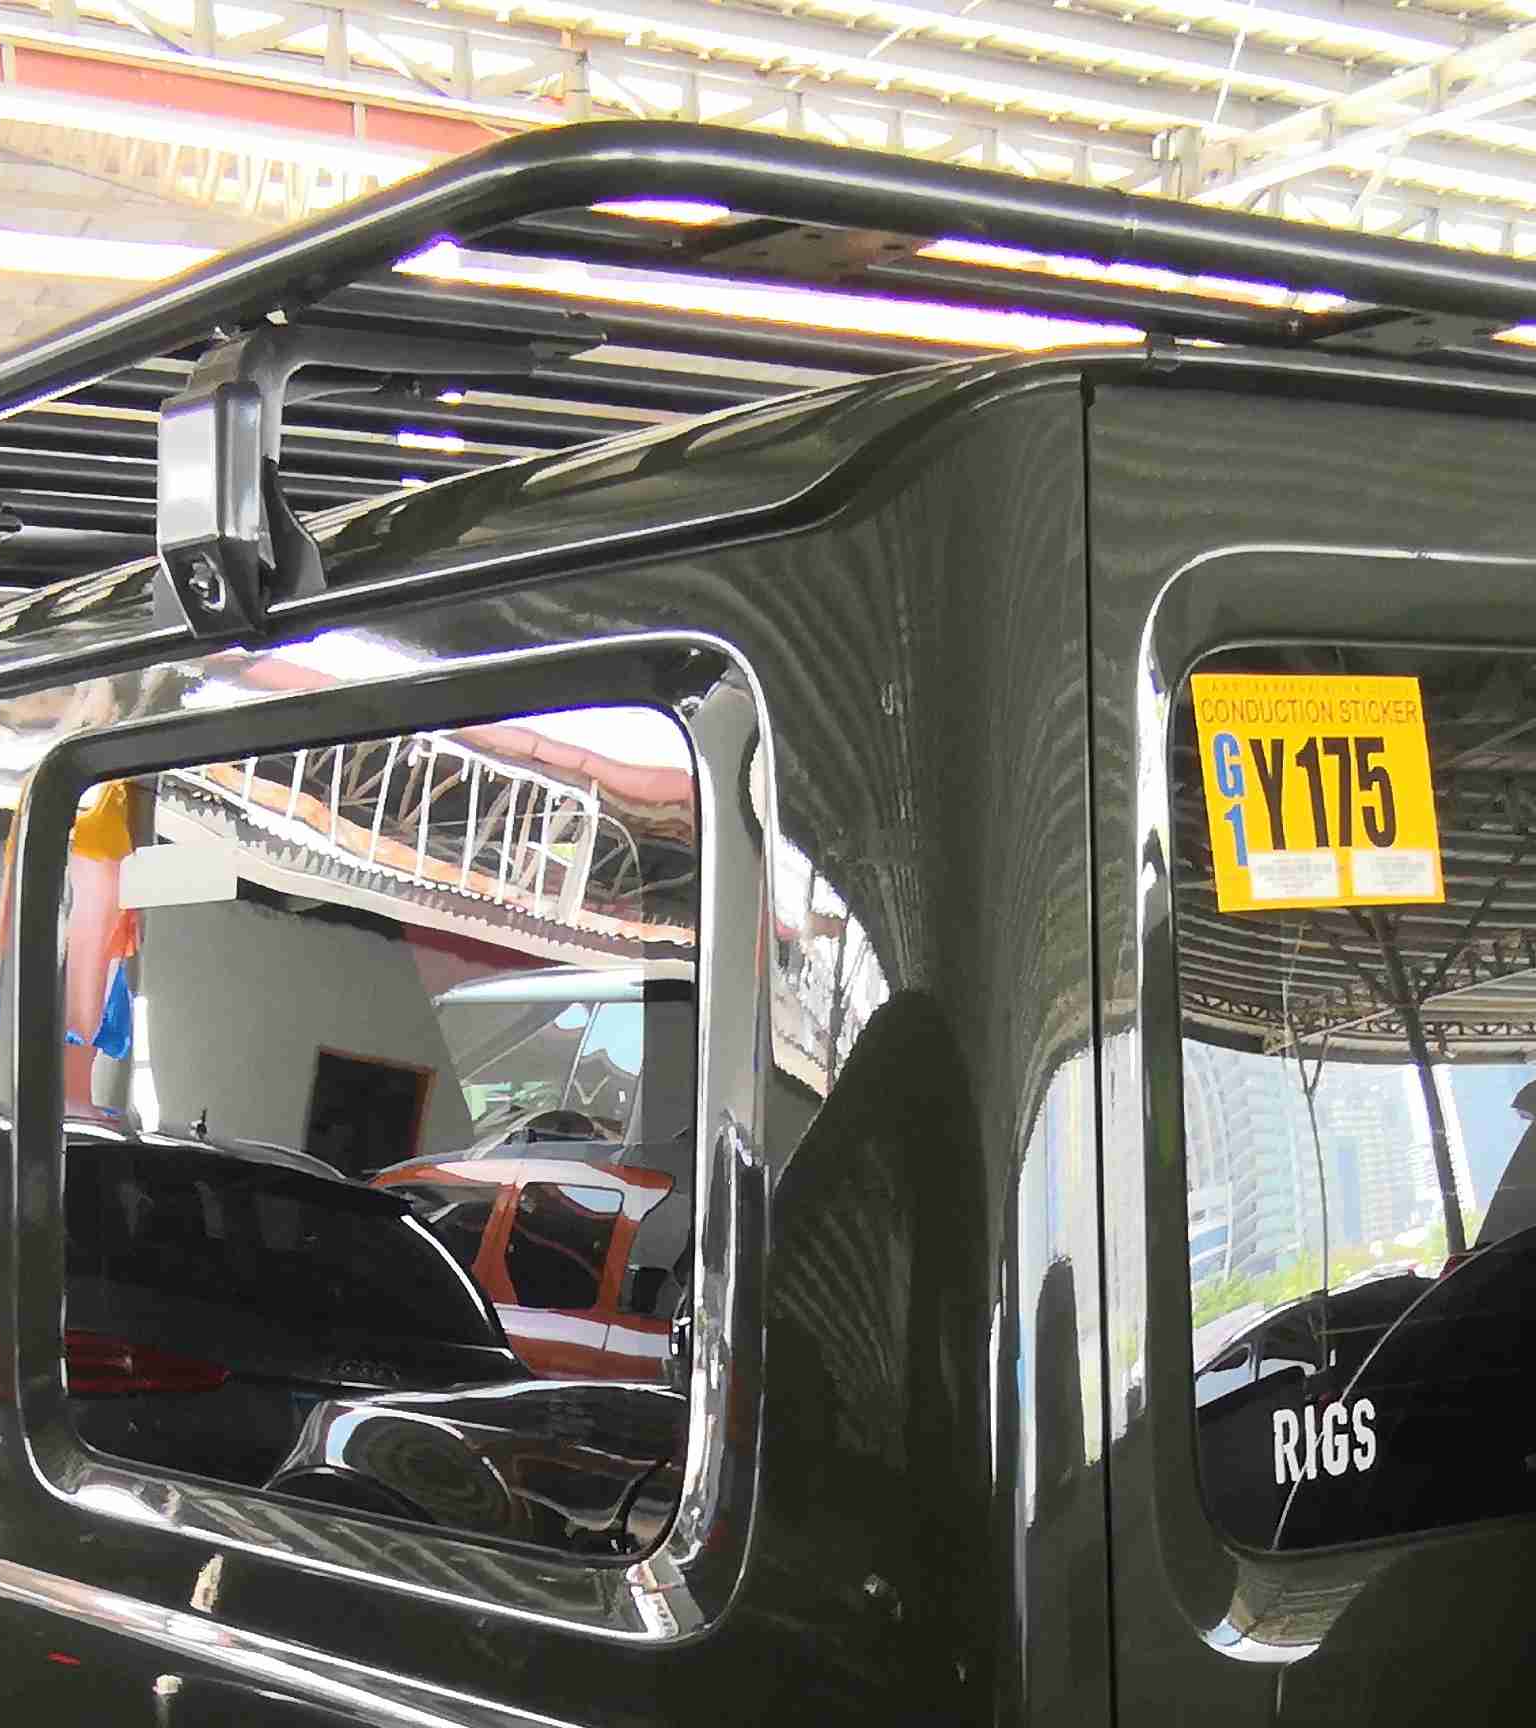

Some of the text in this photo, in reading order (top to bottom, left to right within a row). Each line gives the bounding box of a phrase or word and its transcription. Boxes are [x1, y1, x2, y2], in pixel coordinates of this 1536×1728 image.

[1200, 697, 1418, 724] CONDUCTION STICKER
[1248, 736, 1397, 851] Y175
[1273, 1398, 1377, 1485] RIGS
